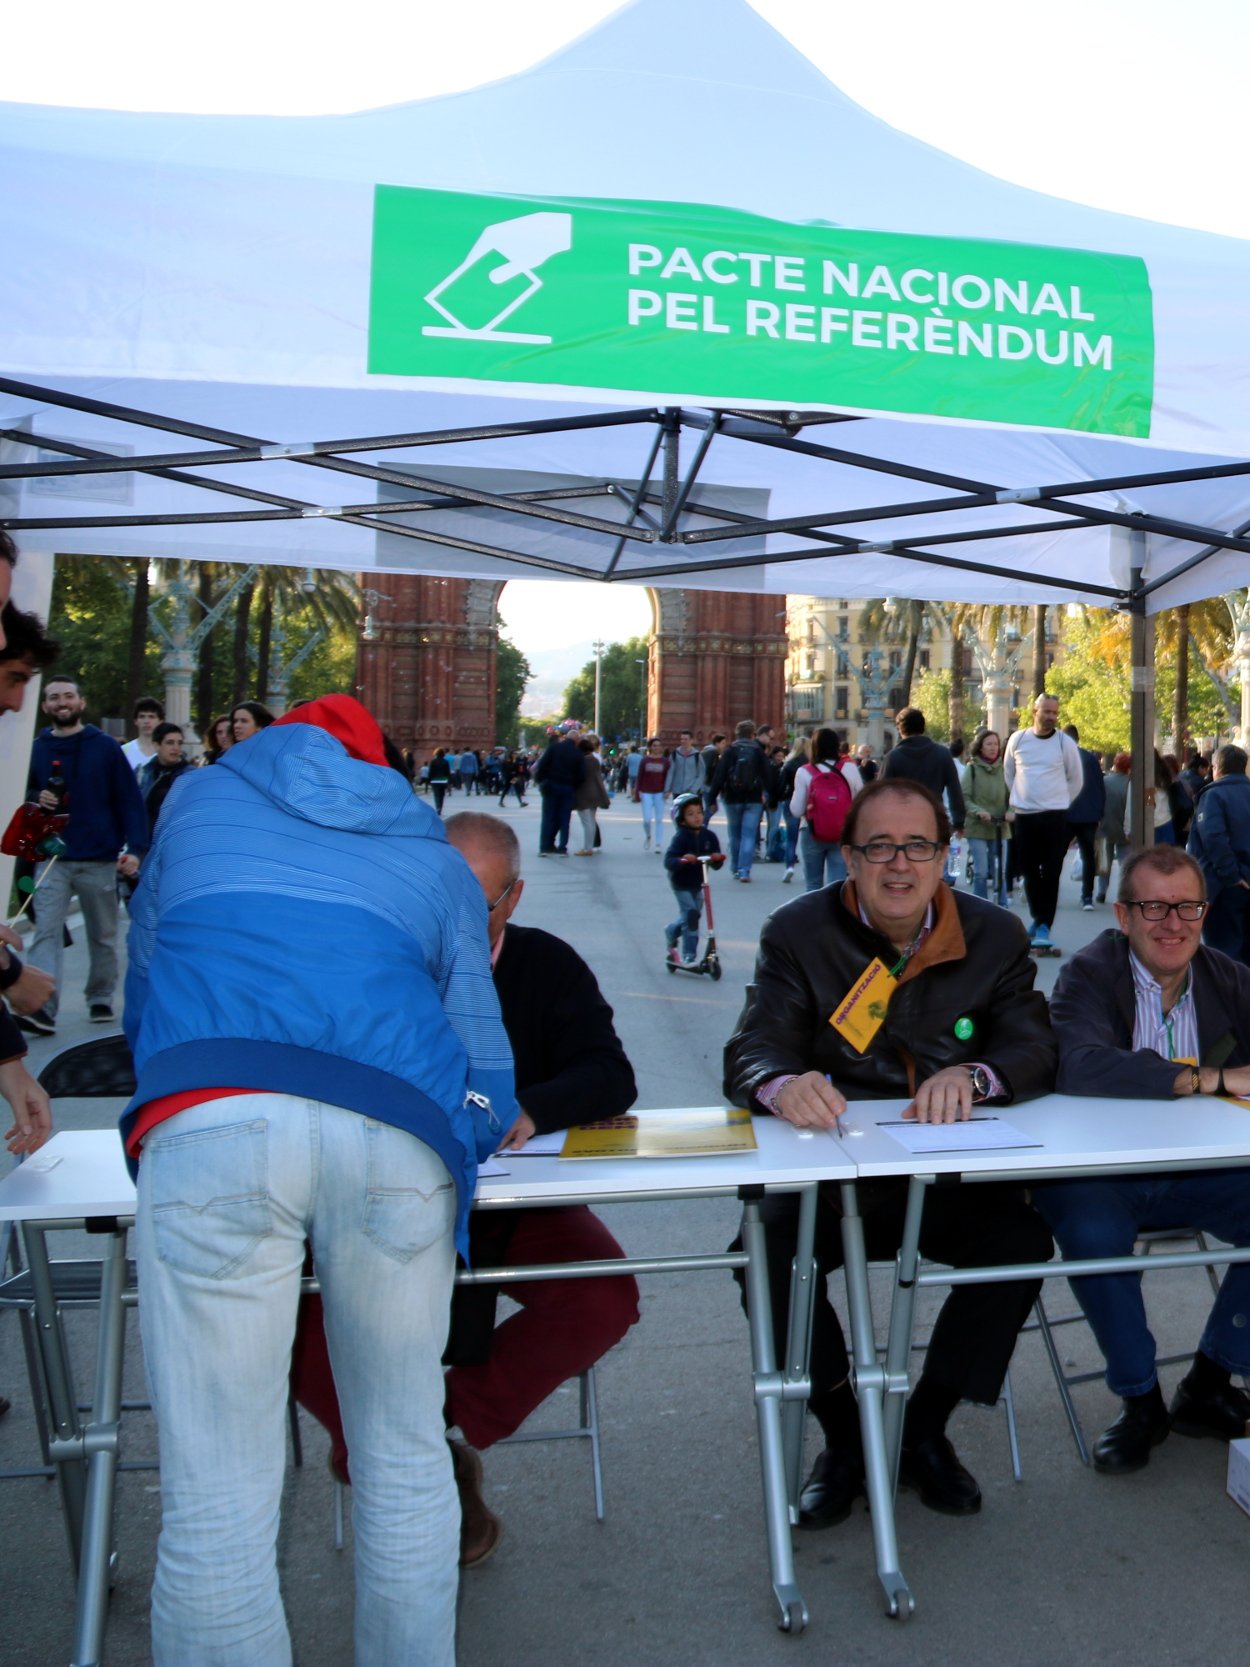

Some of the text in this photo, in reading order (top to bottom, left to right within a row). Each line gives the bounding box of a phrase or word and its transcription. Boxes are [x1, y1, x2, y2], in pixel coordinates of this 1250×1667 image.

[628, 243, 1096, 323] PACTE NACIONAL
[628, 288, 1114, 371] PEL REFERÈNDUM
[836, 963, 881, 1025] ORGANITZACIÓ
